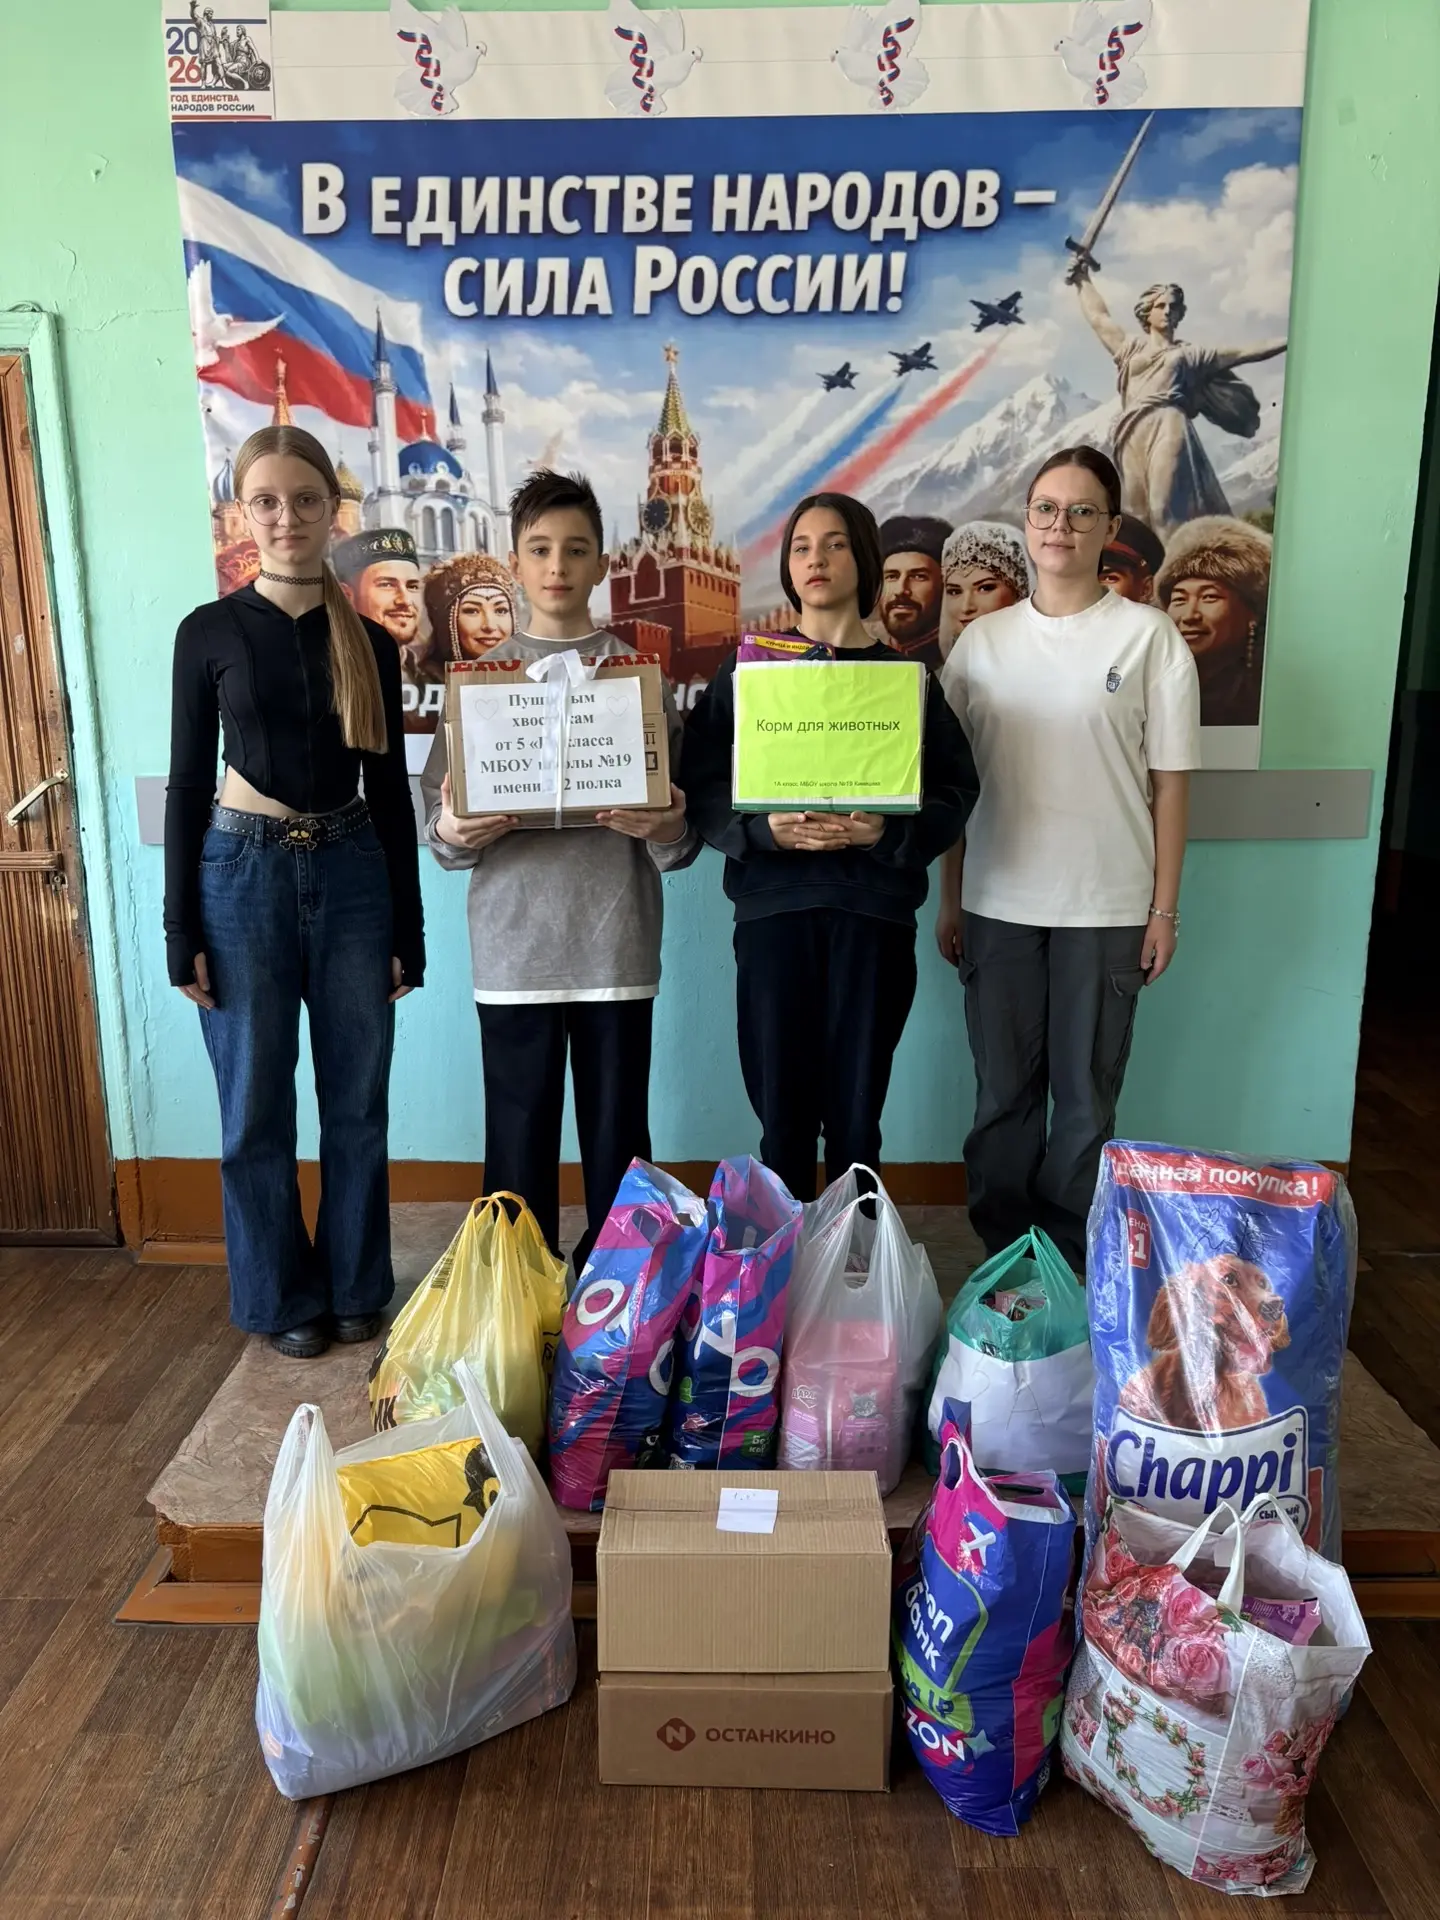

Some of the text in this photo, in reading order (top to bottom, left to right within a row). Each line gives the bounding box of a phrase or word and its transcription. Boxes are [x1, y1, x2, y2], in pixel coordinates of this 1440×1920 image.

[166, 26, 200, 55] 20
[168, 55, 201, 83] 26
[170, 94, 240, 103] ГОД ЕДИНСТВА
[171, 104, 255, 112] НАРОДОВ РОССИИ
[301, 163, 346, 235] В
[371, 174, 694, 246] ЕДИНСТВЕ
[712, 169, 1000, 241] НАРОДОВ
[444, 257, 612, 316] СИЛА
[508, 694, 595, 709] Пушым
[756, 719, 900, 734] Корм для животных
[495, 741, 512, 751] от
[516, 737, 526, 750] 5
[480, 758, 533, 773] МБОУ
[597, 753, 632, 767] №19
[493, 783, 541, 794] имени
[576, 778, 622, 790] полка
[1113, 1159, 1318, 1196] дачная покупка!
[1106, 1430, 1297, 1515] Chappi
[705, 1728, 836, 1744] ОСТАНКИНО
